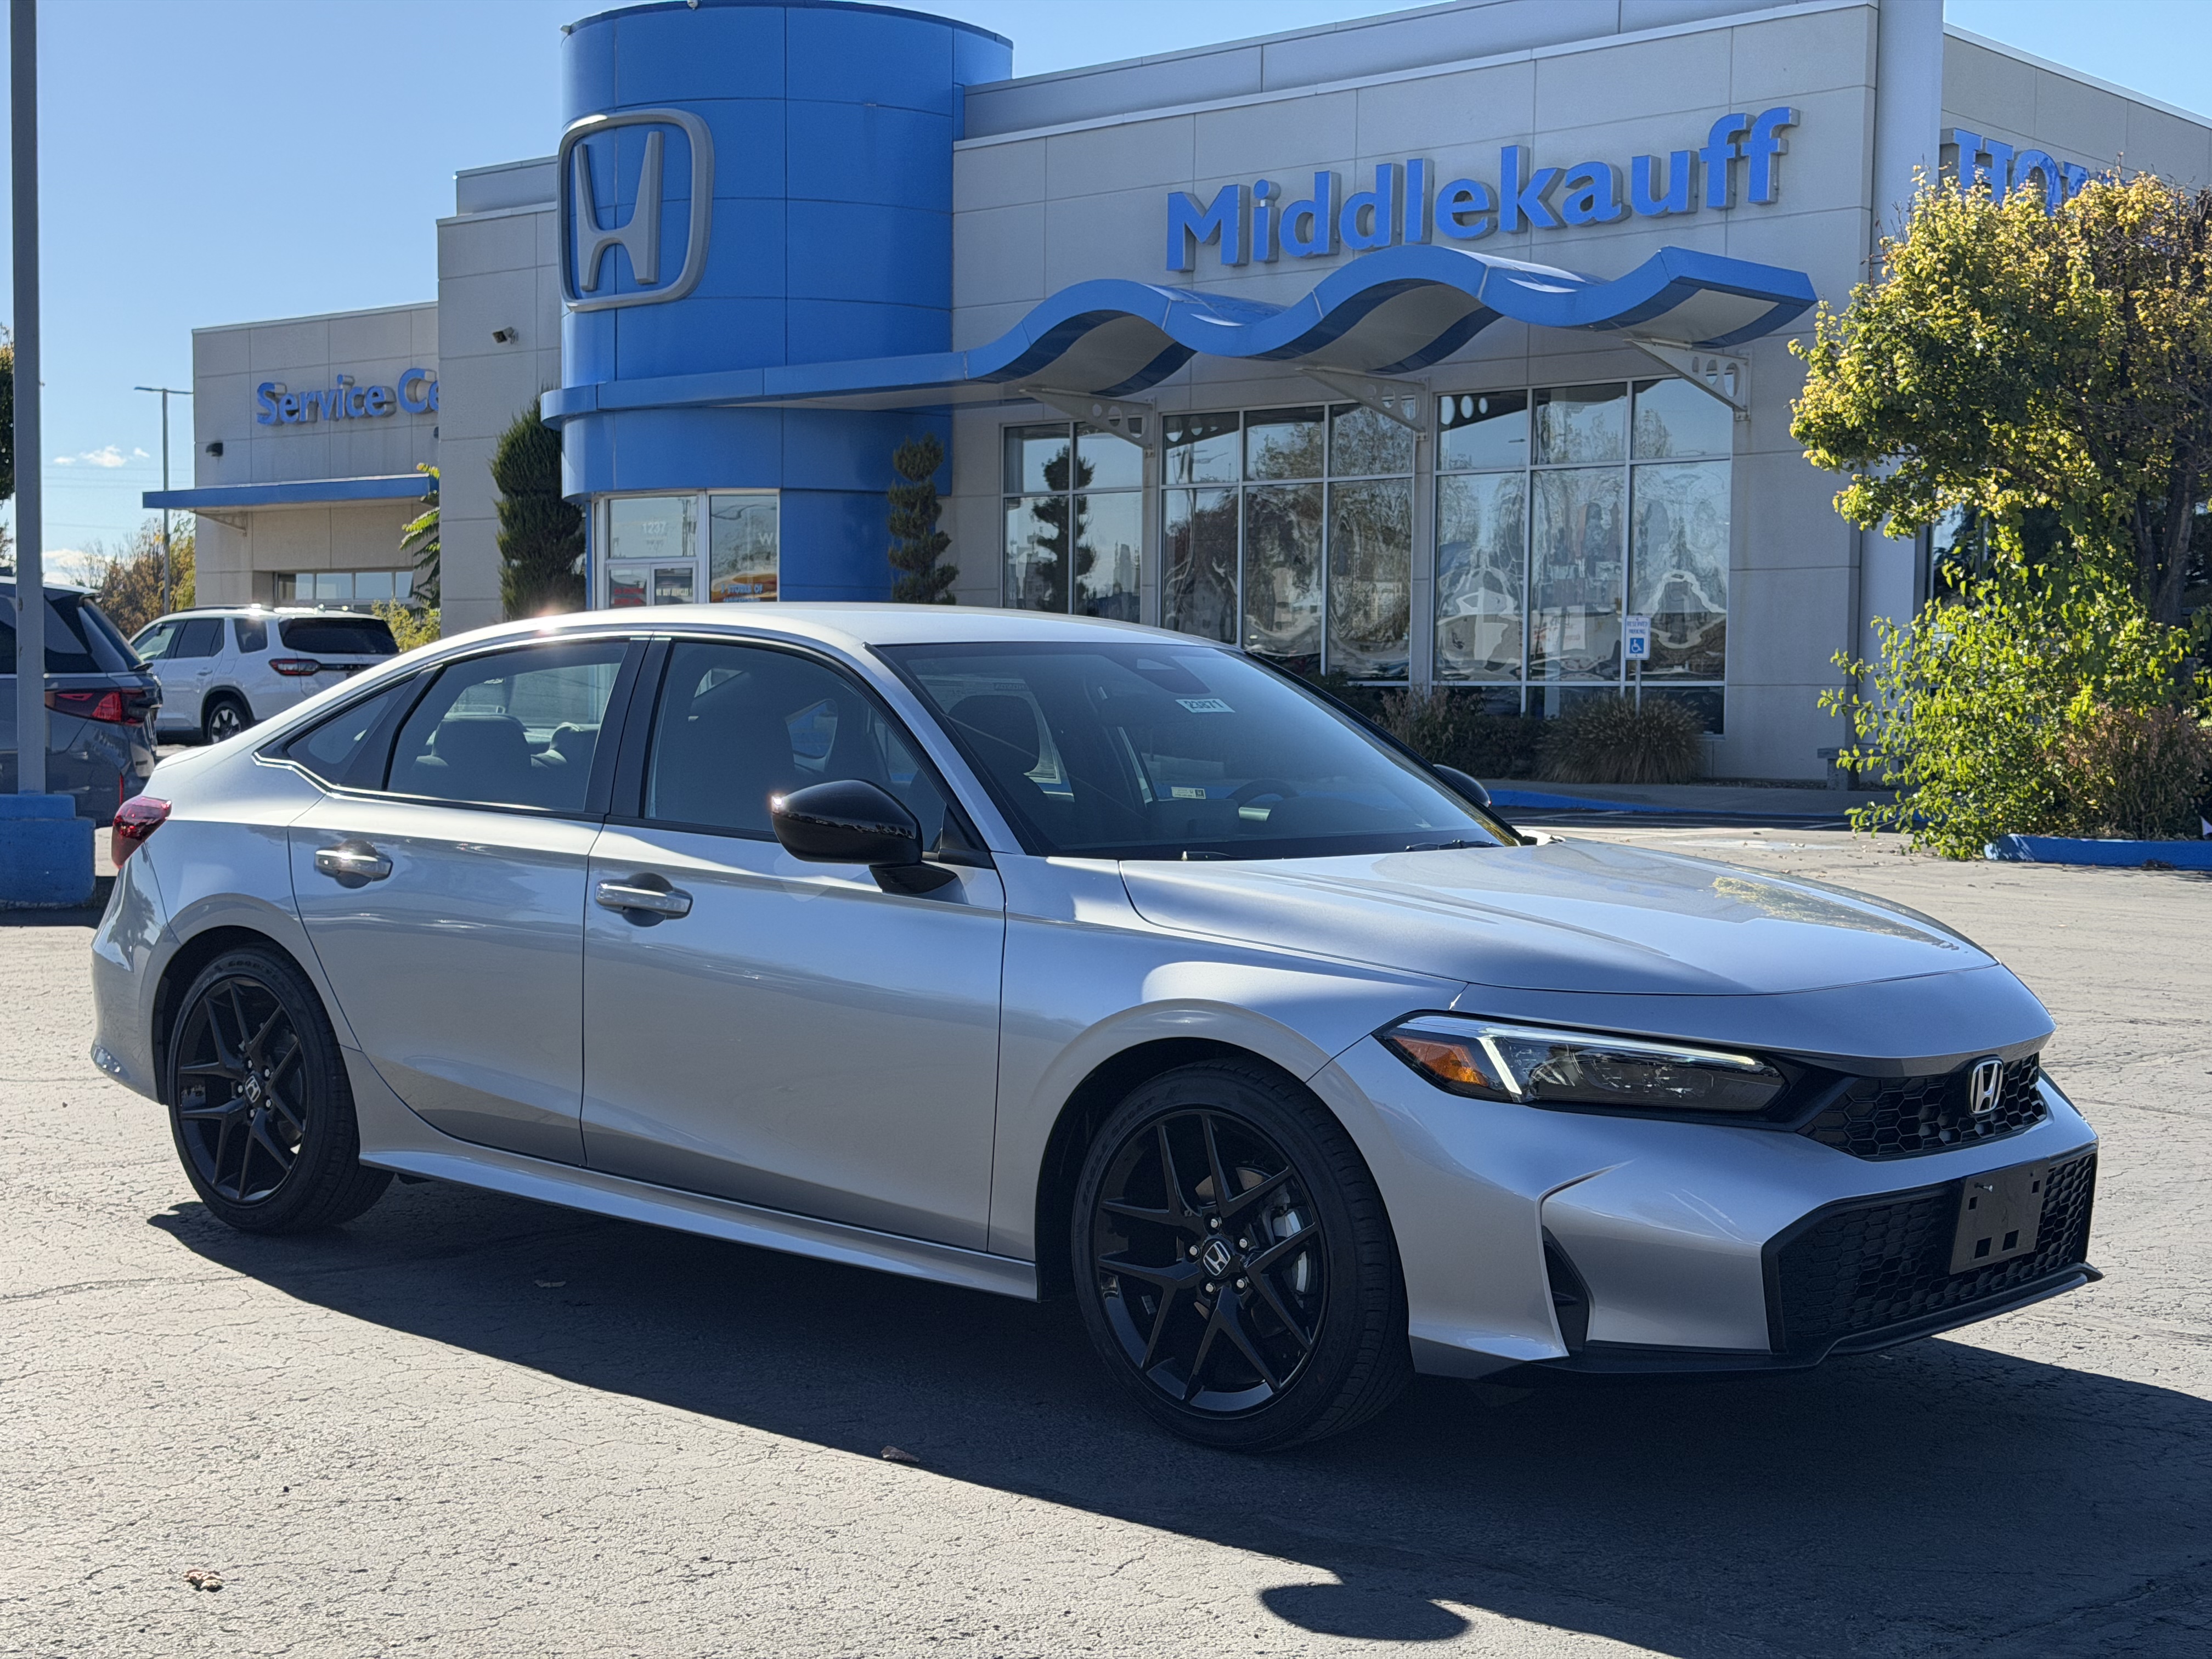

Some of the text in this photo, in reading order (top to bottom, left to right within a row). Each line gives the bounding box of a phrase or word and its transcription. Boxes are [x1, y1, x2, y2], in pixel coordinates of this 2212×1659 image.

[1166, 107, 1798, 272] Middlekauff
[256, 374, 388, 425] Service
[642, 522, 667, 534] 1237
[1183, 699, 1224, 709] 23871
